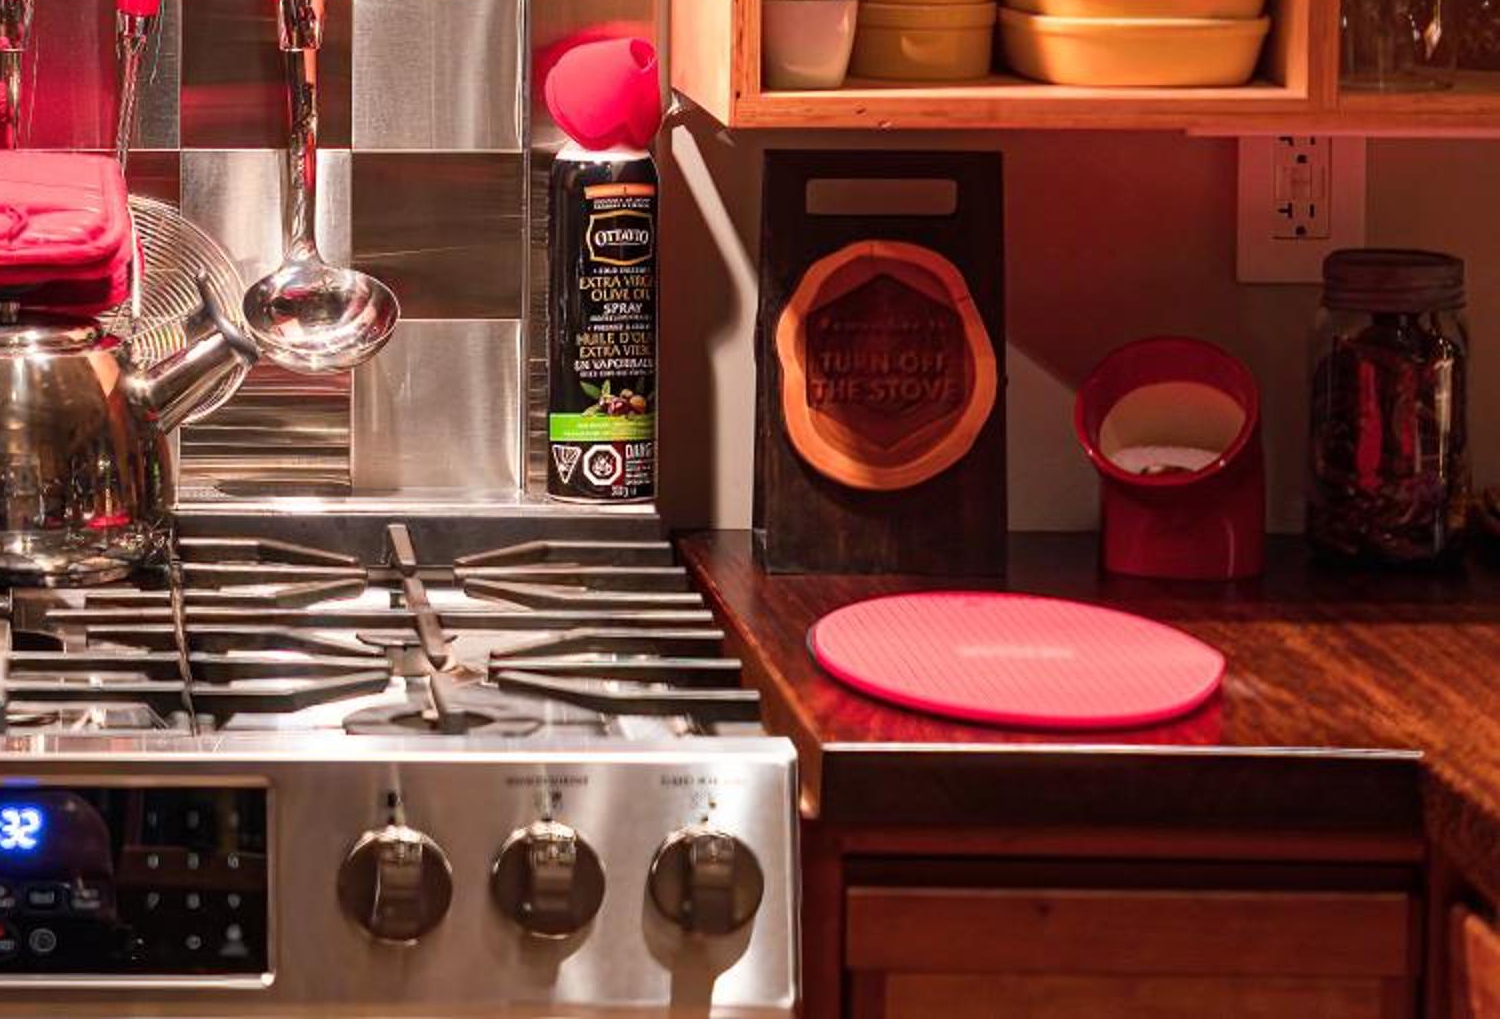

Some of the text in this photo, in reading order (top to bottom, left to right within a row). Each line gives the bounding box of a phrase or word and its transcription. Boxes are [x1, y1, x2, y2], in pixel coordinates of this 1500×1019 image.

[579, 275, 621, 290] EXTRA
[591, 288, 631, 302] OLIVE
[603, 302, 643, 315] SPRAY
